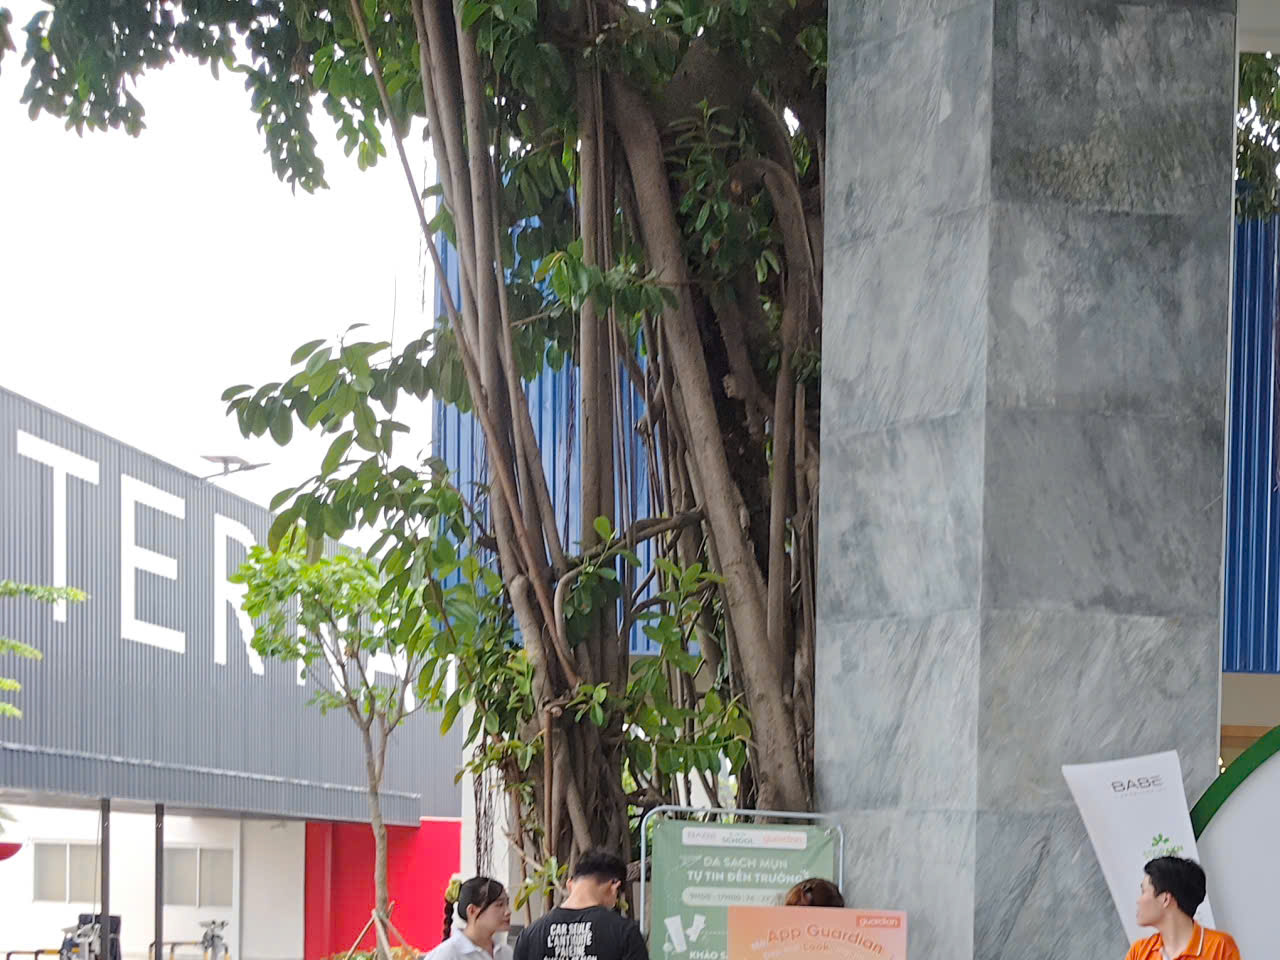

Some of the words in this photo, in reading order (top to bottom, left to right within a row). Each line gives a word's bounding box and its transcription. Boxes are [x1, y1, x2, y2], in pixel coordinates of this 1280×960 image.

[1111, 775, 1164, 793] BABE
[703, 855, 722, 867] DA
[704, 871, 724, 882] TIN
[768, 929, 801, 943] App
[806, 924, 885, 955] Guardian
